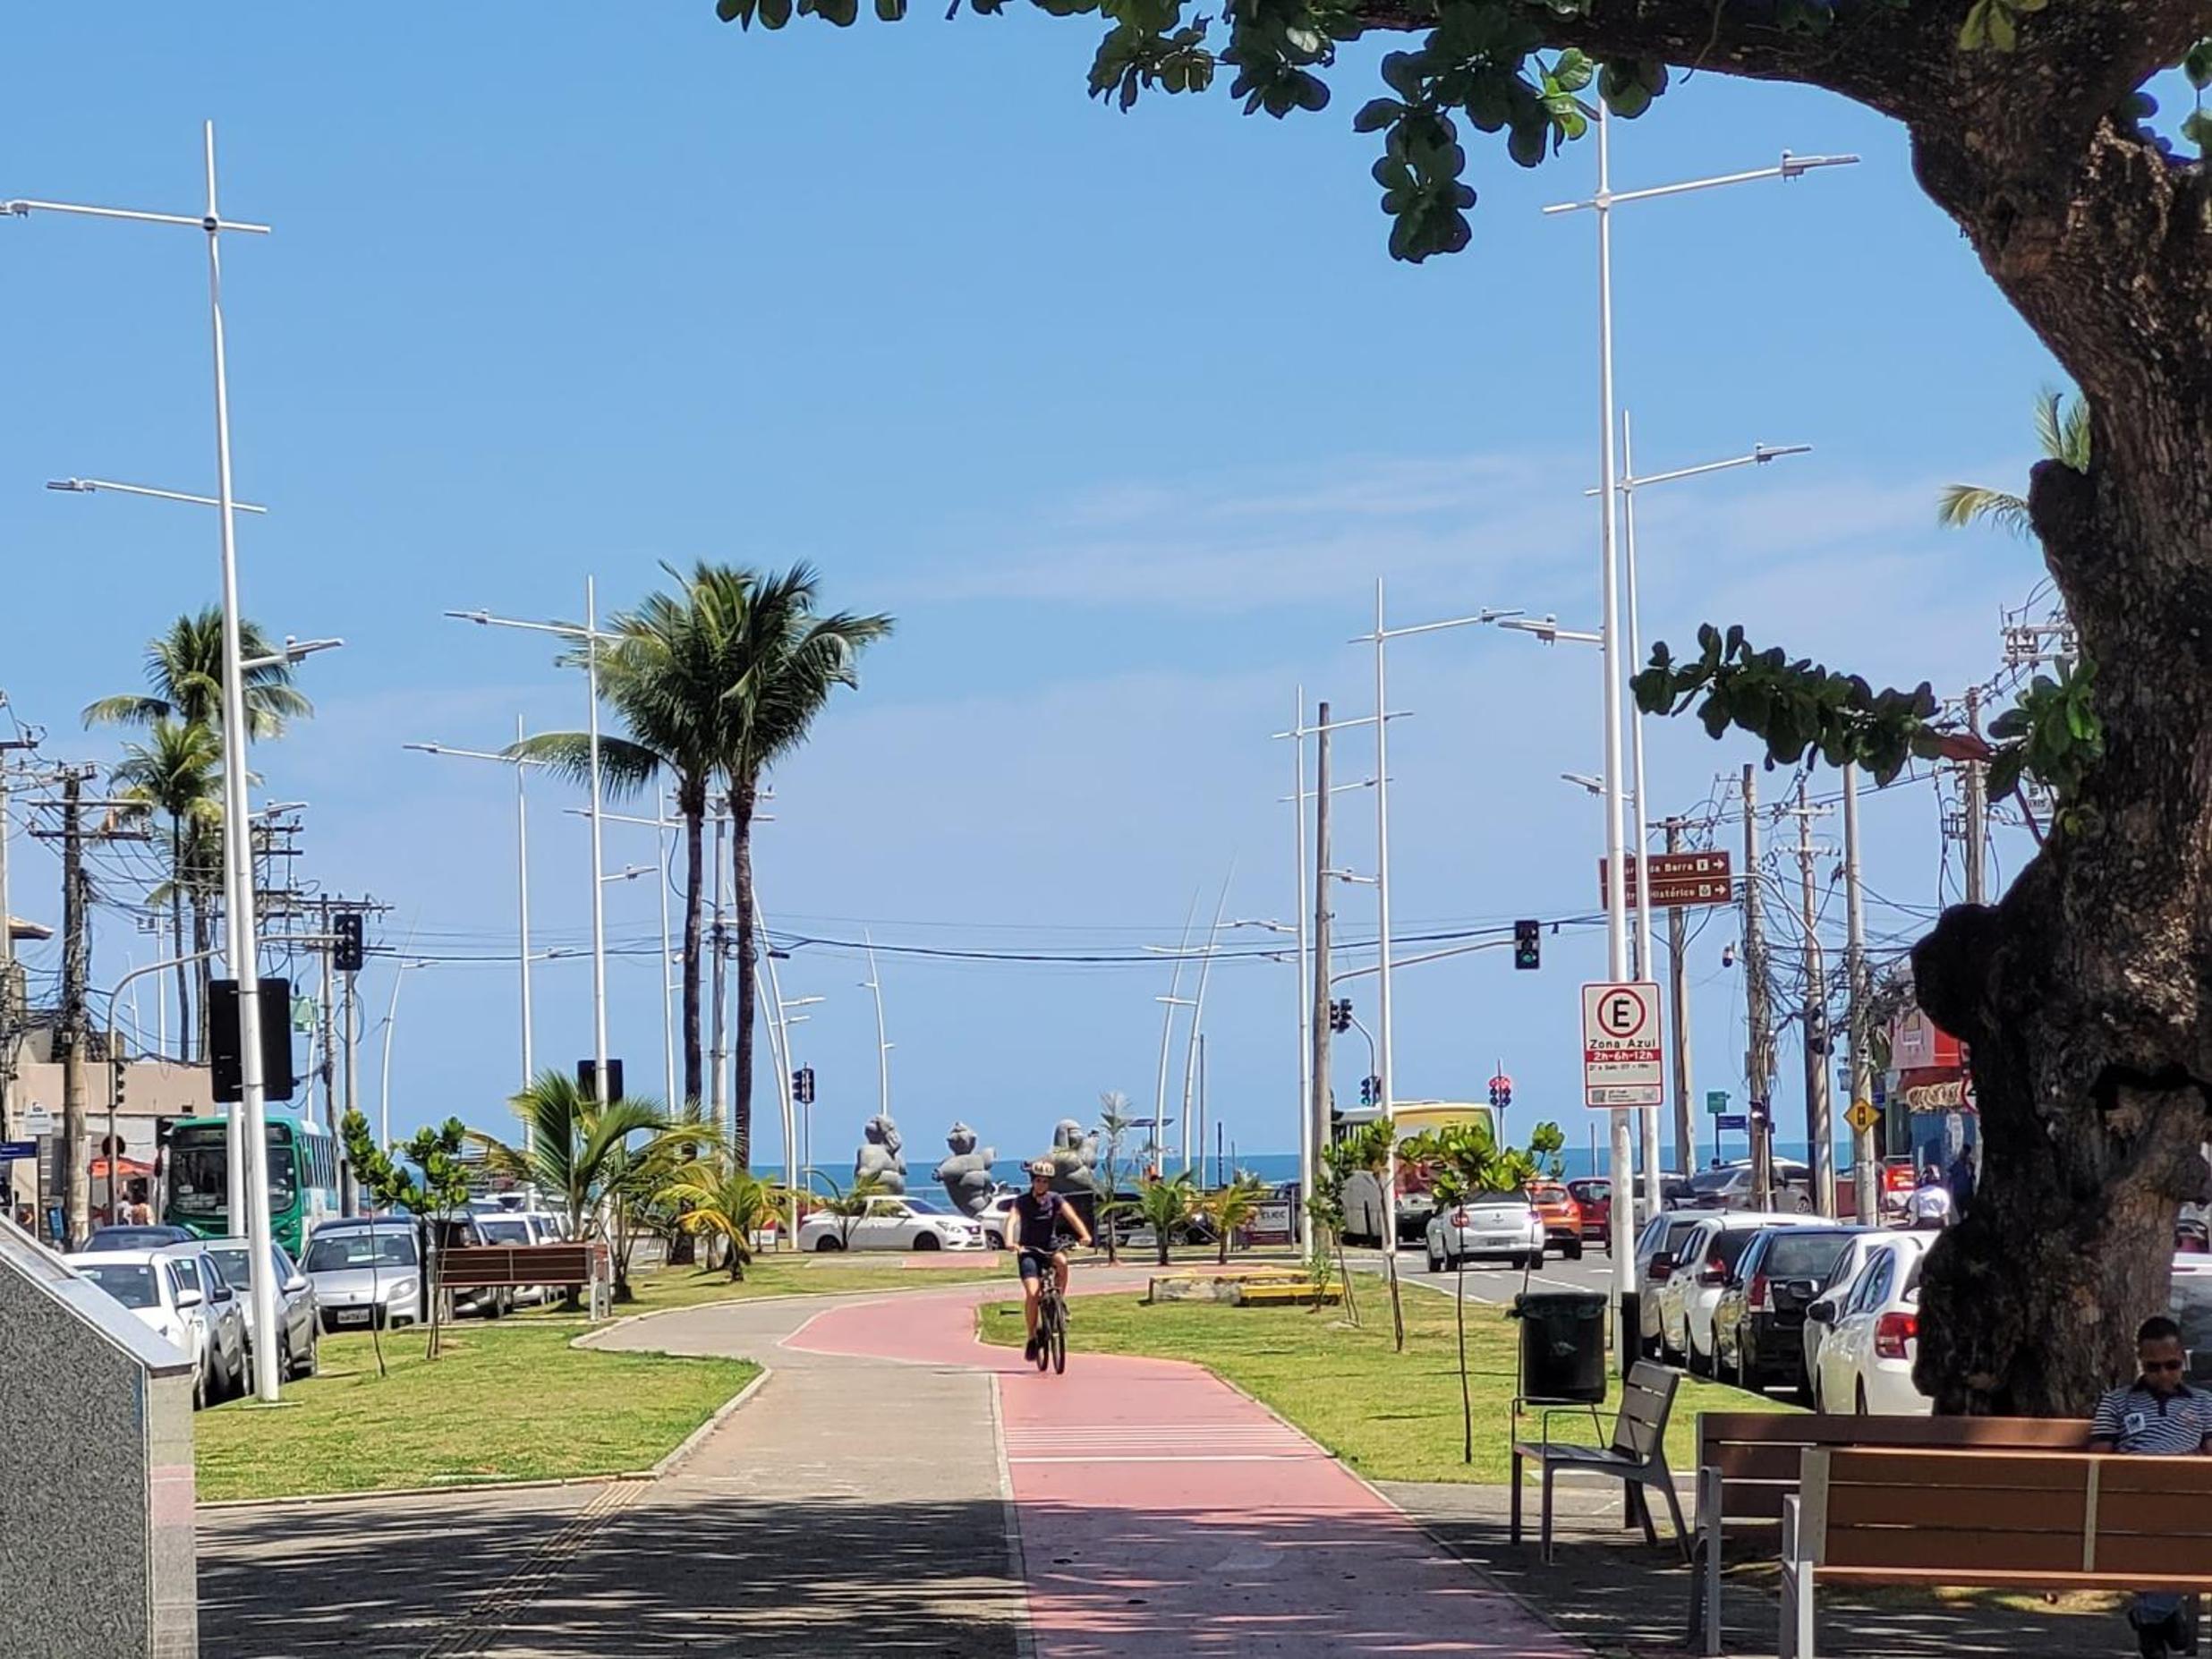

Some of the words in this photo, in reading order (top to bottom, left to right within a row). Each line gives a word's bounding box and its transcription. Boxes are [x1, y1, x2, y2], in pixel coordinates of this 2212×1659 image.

[1664, 863, 1693, 872] Barra
[1612, 999, 1629, 1027] E
[1589, 1039, 1621, 1049] Zona
[1627, 1038, 1655, 1049] Azul
[1593, 1051, 1654, 1061] 2h-6h-12h
